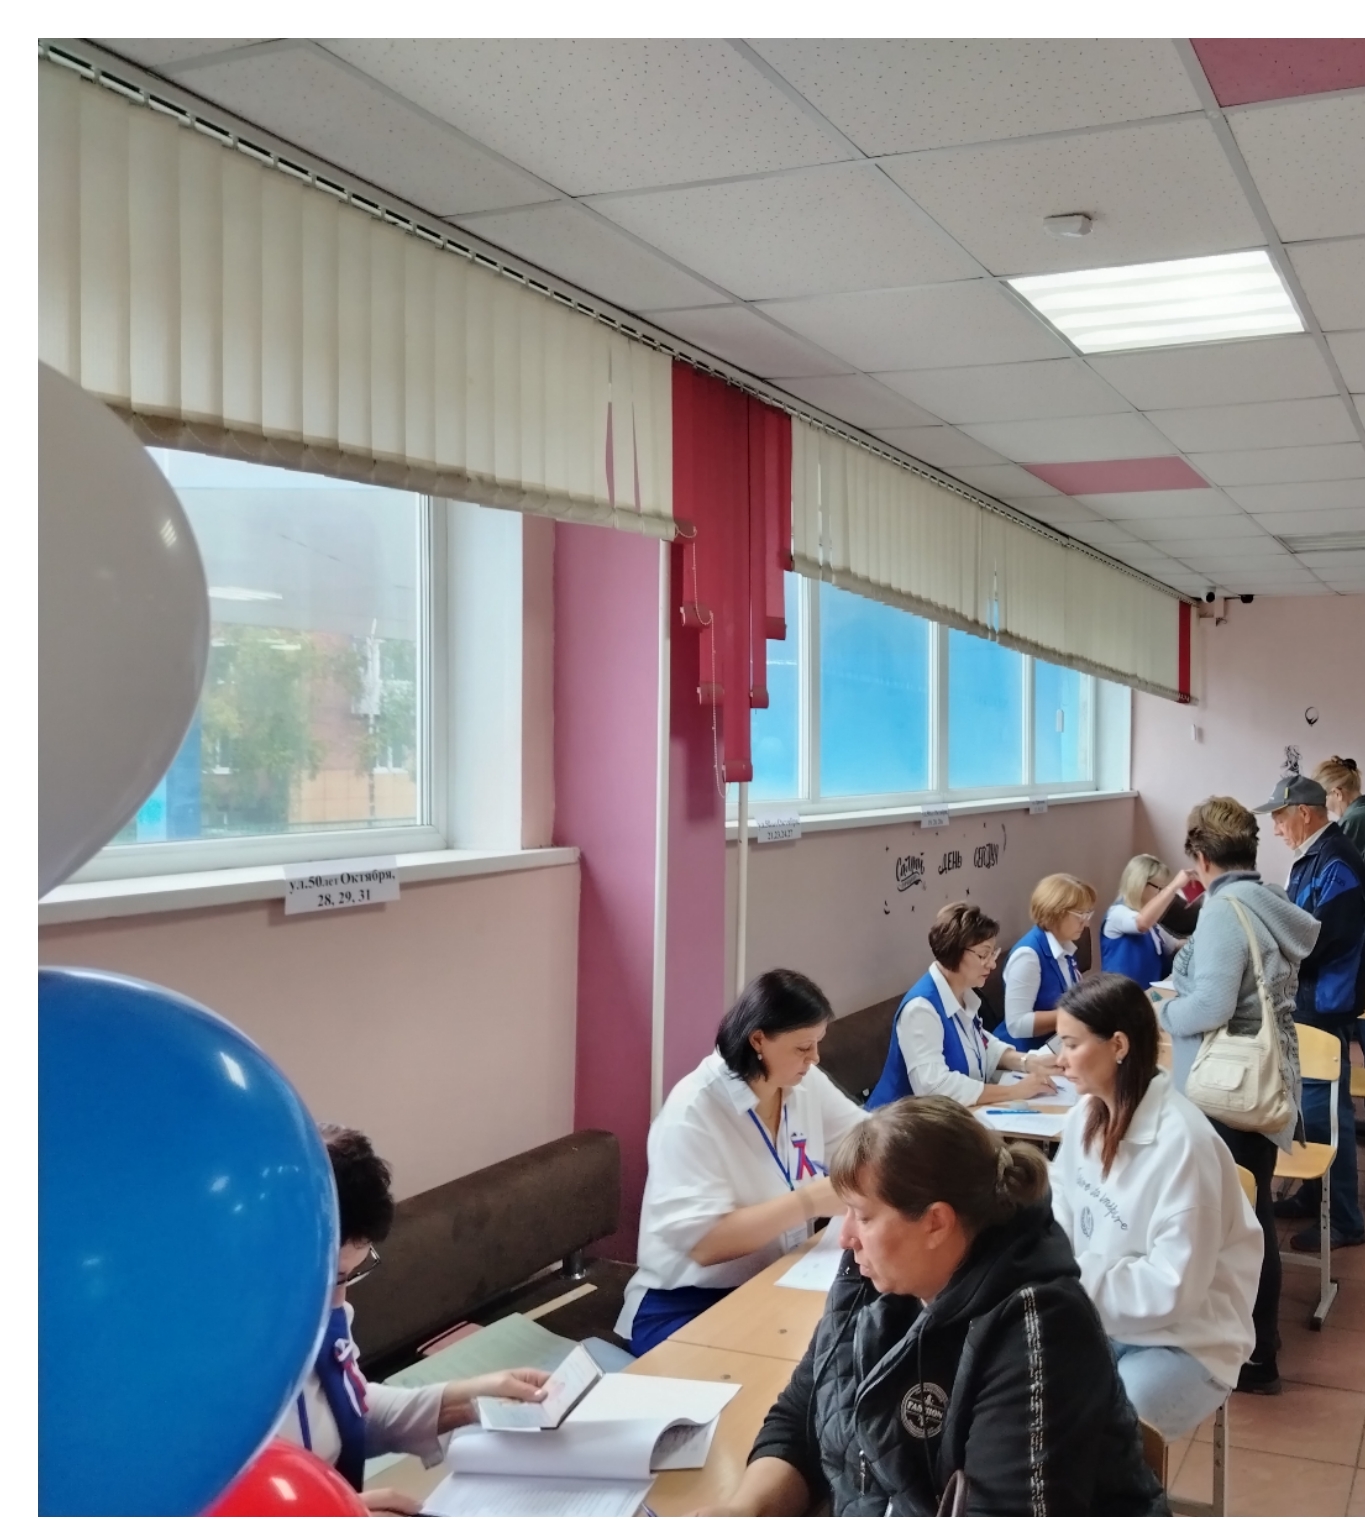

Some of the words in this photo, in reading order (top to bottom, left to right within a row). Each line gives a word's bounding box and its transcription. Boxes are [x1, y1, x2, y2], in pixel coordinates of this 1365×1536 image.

[340, 869, 396, 886] Октября,
[317, 894, 335, 908] 28,
[339, 891, 356, 904] 29,
[358, 889, 371, 902] 31
